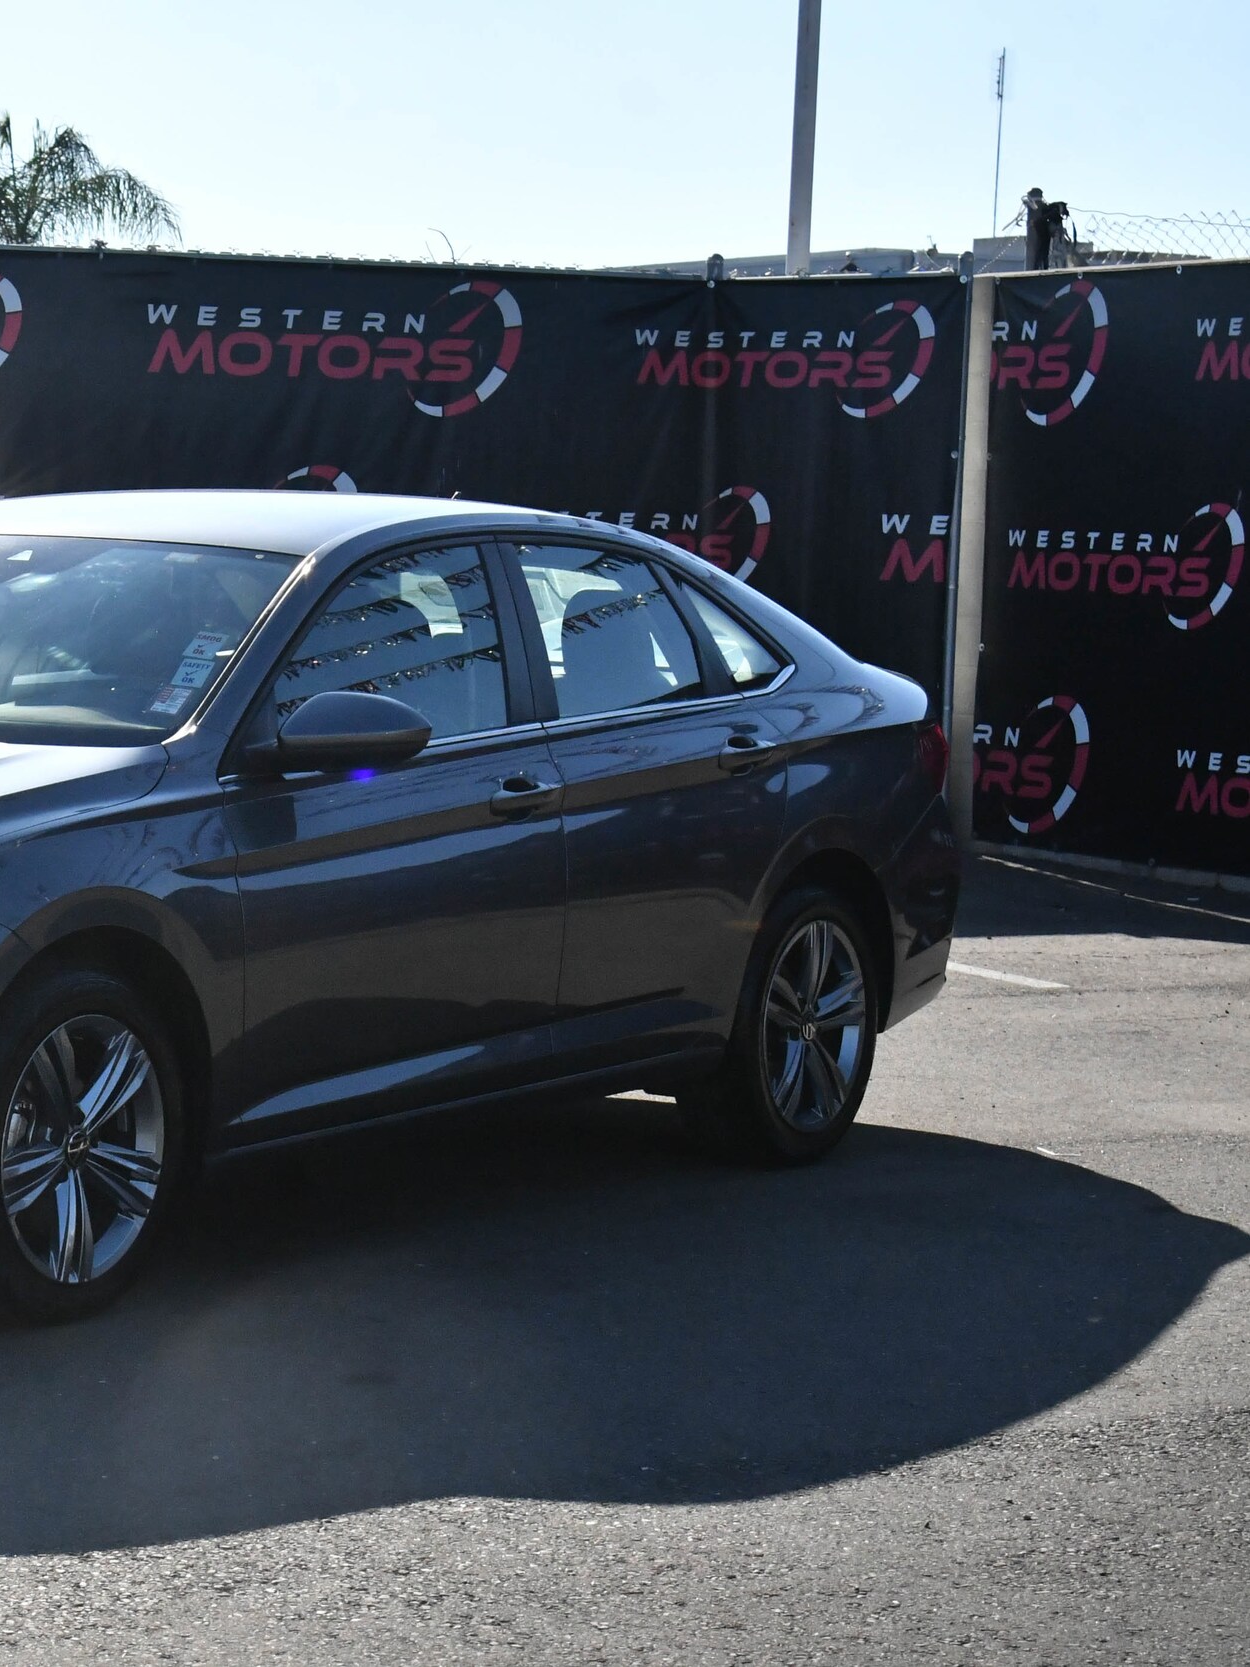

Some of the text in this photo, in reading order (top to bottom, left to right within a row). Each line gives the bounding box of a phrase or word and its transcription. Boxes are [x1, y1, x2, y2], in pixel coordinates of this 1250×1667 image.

[147, 304, 427, 333] WESTERN
[635, 329, 856, 348] WESTERN
[147, 329, 475, 382] MOTORS
[636, 349, 894, 389] MOTORS
[1008, 528, 1179, 553] WESTERN
[1007, 550, 1212, 598] MOTORS
[196, 634, 222, 643] SMOG
[183, 661, 212, 669] SAFETY
